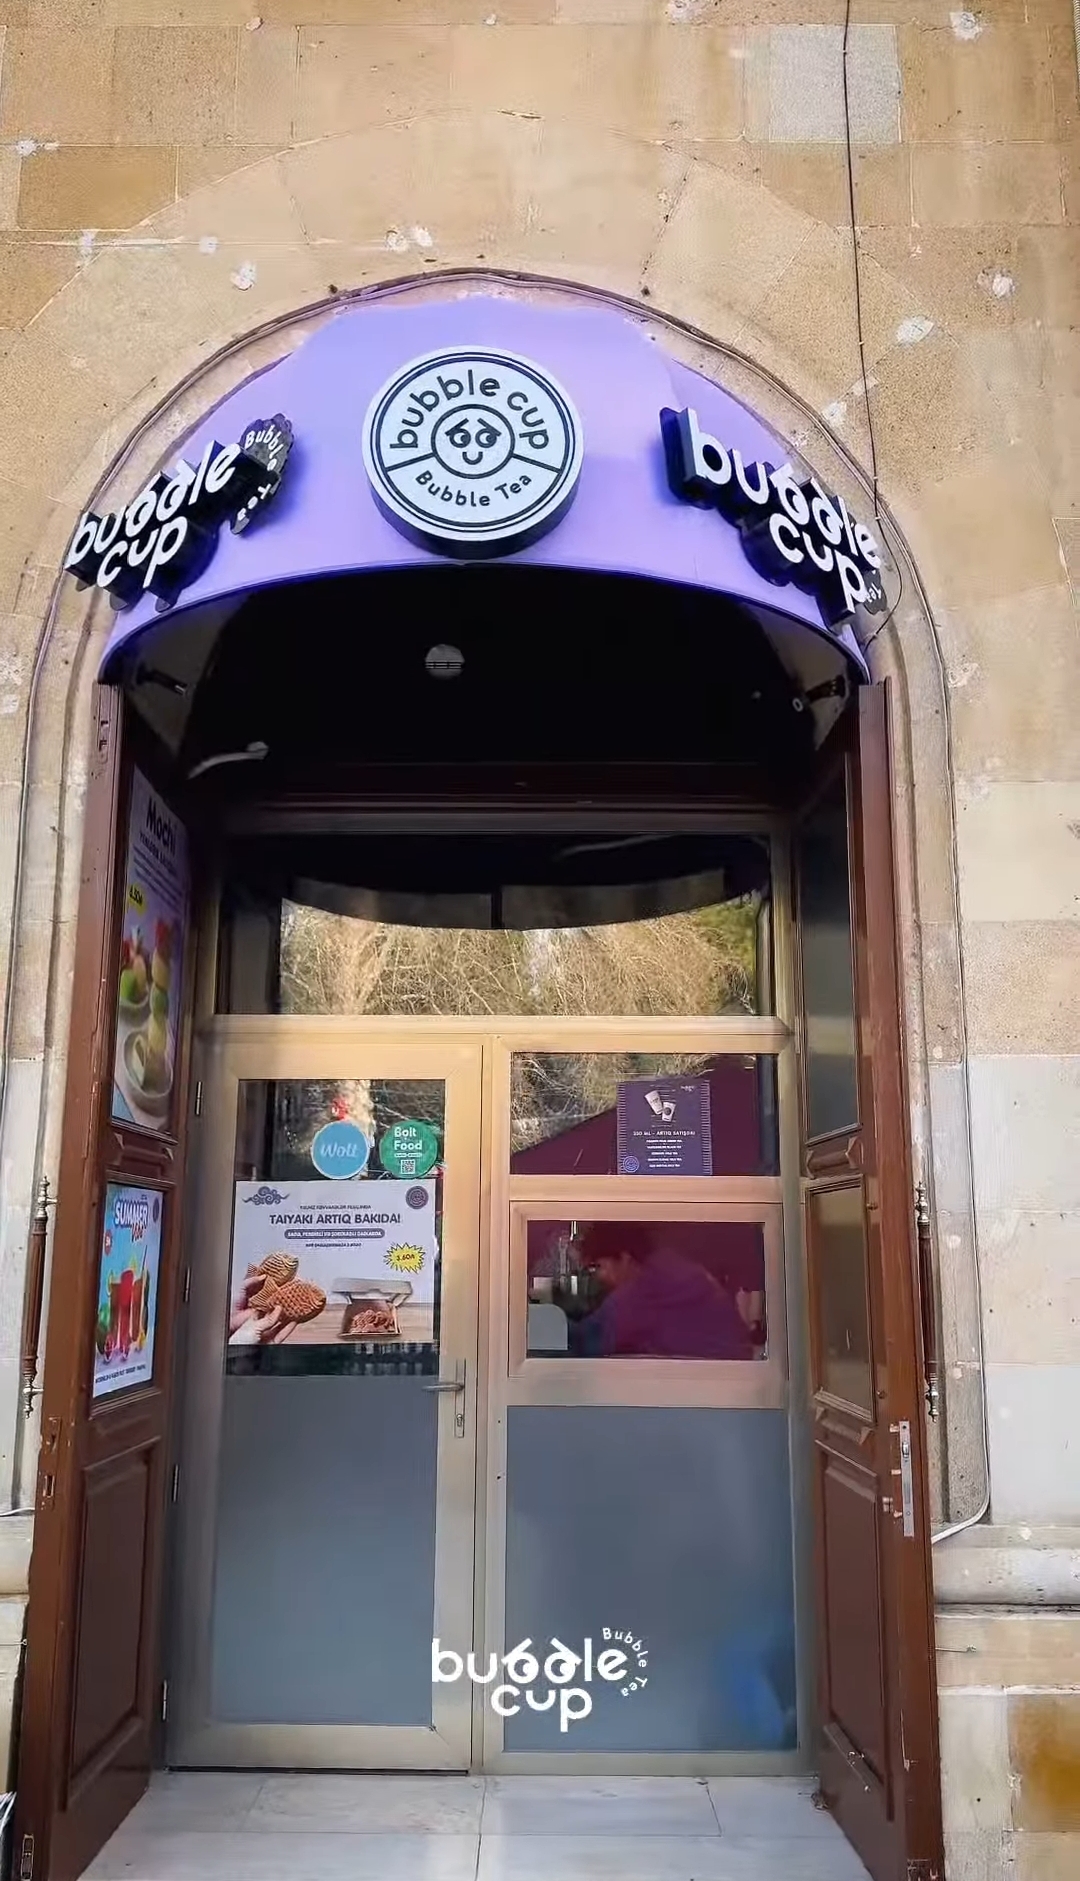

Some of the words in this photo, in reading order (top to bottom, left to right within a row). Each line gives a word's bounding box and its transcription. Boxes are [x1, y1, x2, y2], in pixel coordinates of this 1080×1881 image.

[389, 369, 501, 449] bubble
[507, 392, 550, 450] cup
[64, 440, 242, 570] bubble
[415, 470, 491, 507] Bubble
[494, 475, 532, 499] Tea
[687, 407, 881, 569] bubble
[97, 516, 188, 588] cup
[769, 513, 868, 613] cup
[146, 797, 177, 856] Mochi
[320, 1142, 358, 1158] Wolt
[394, 1126, 417, 1138] Bolt
[394, 1140, 422, 1151] Food
[114, 1200, 148, 1228] SUMMER
[269, 1214, 313, 1225] TAIYAKI
[316, 1213, 351, 1225] ARTIQ
[354, 1213, 401, 1224] BAKIDA!
